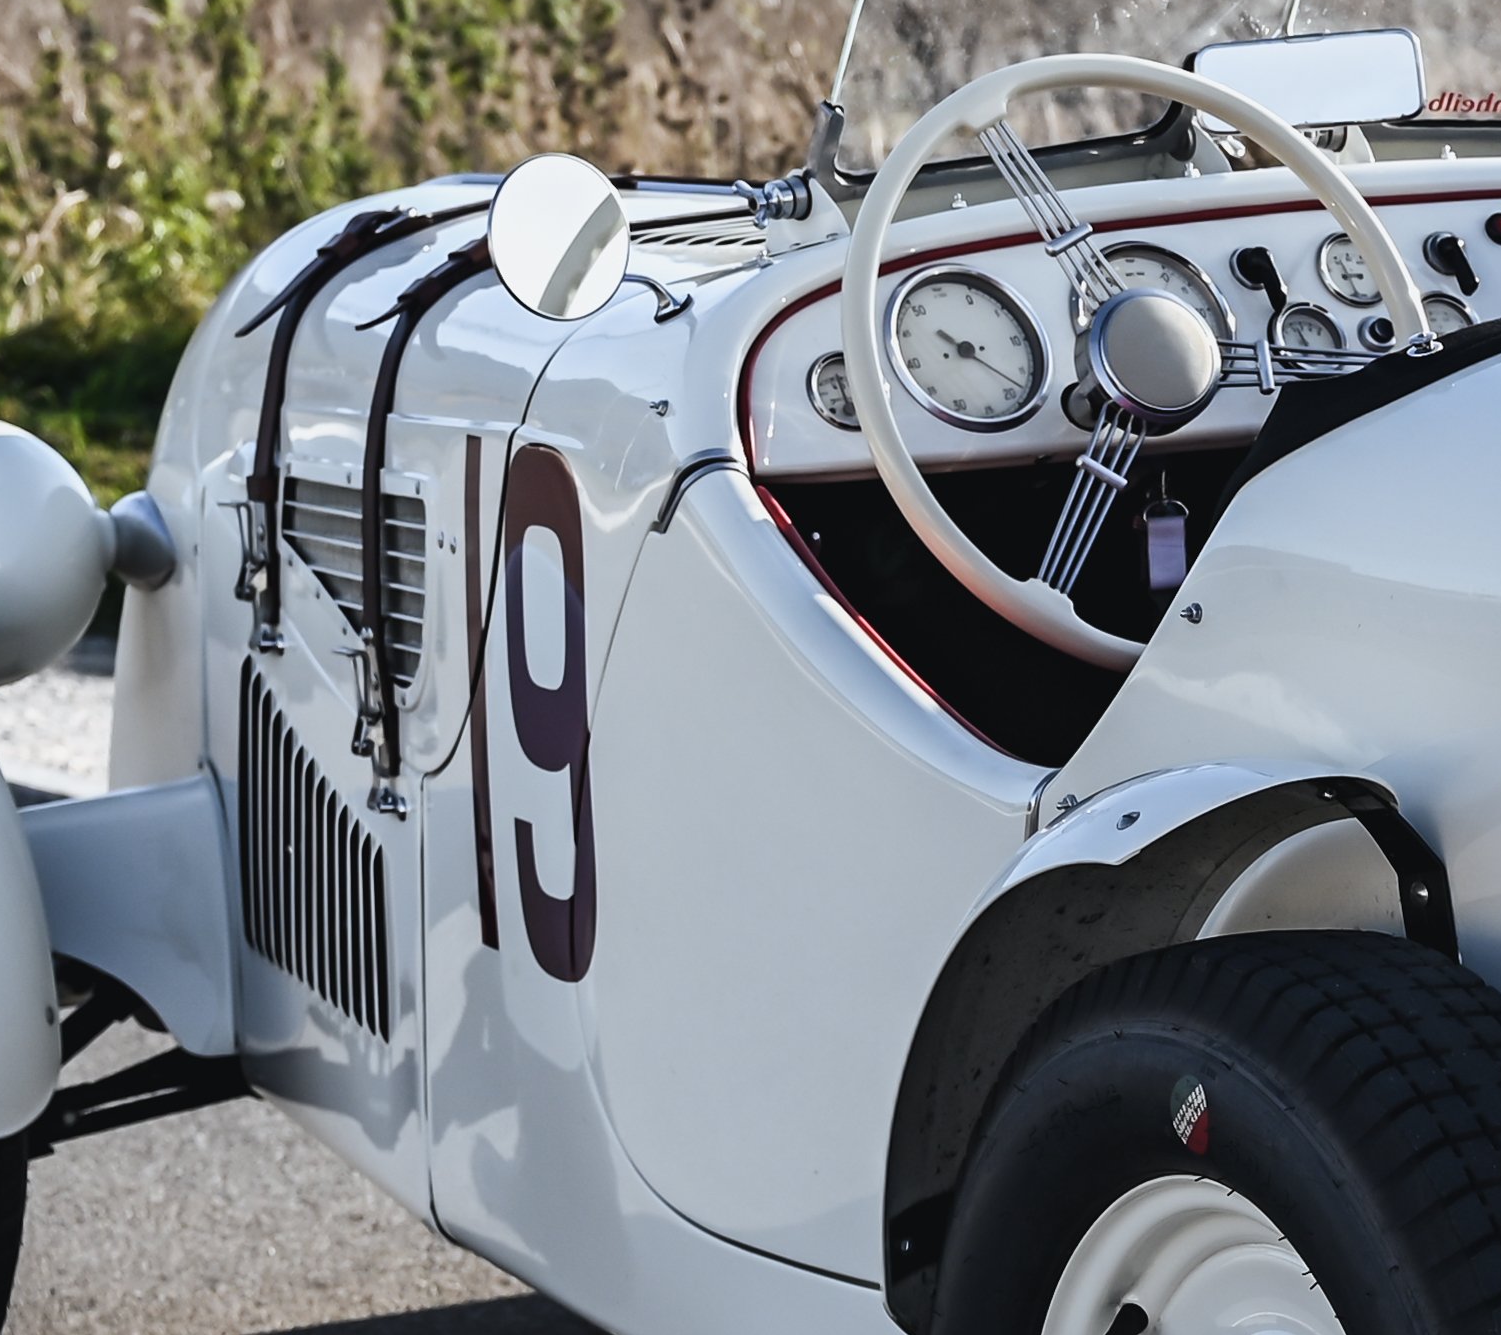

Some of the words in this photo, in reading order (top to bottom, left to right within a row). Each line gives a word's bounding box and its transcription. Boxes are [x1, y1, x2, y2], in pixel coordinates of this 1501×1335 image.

[911, 304, 927, 318] 50
[1009, 334, 1023, 347] 10
[1003, 387, 1017, 401] 20
[464, 434, 599, 984] 19
